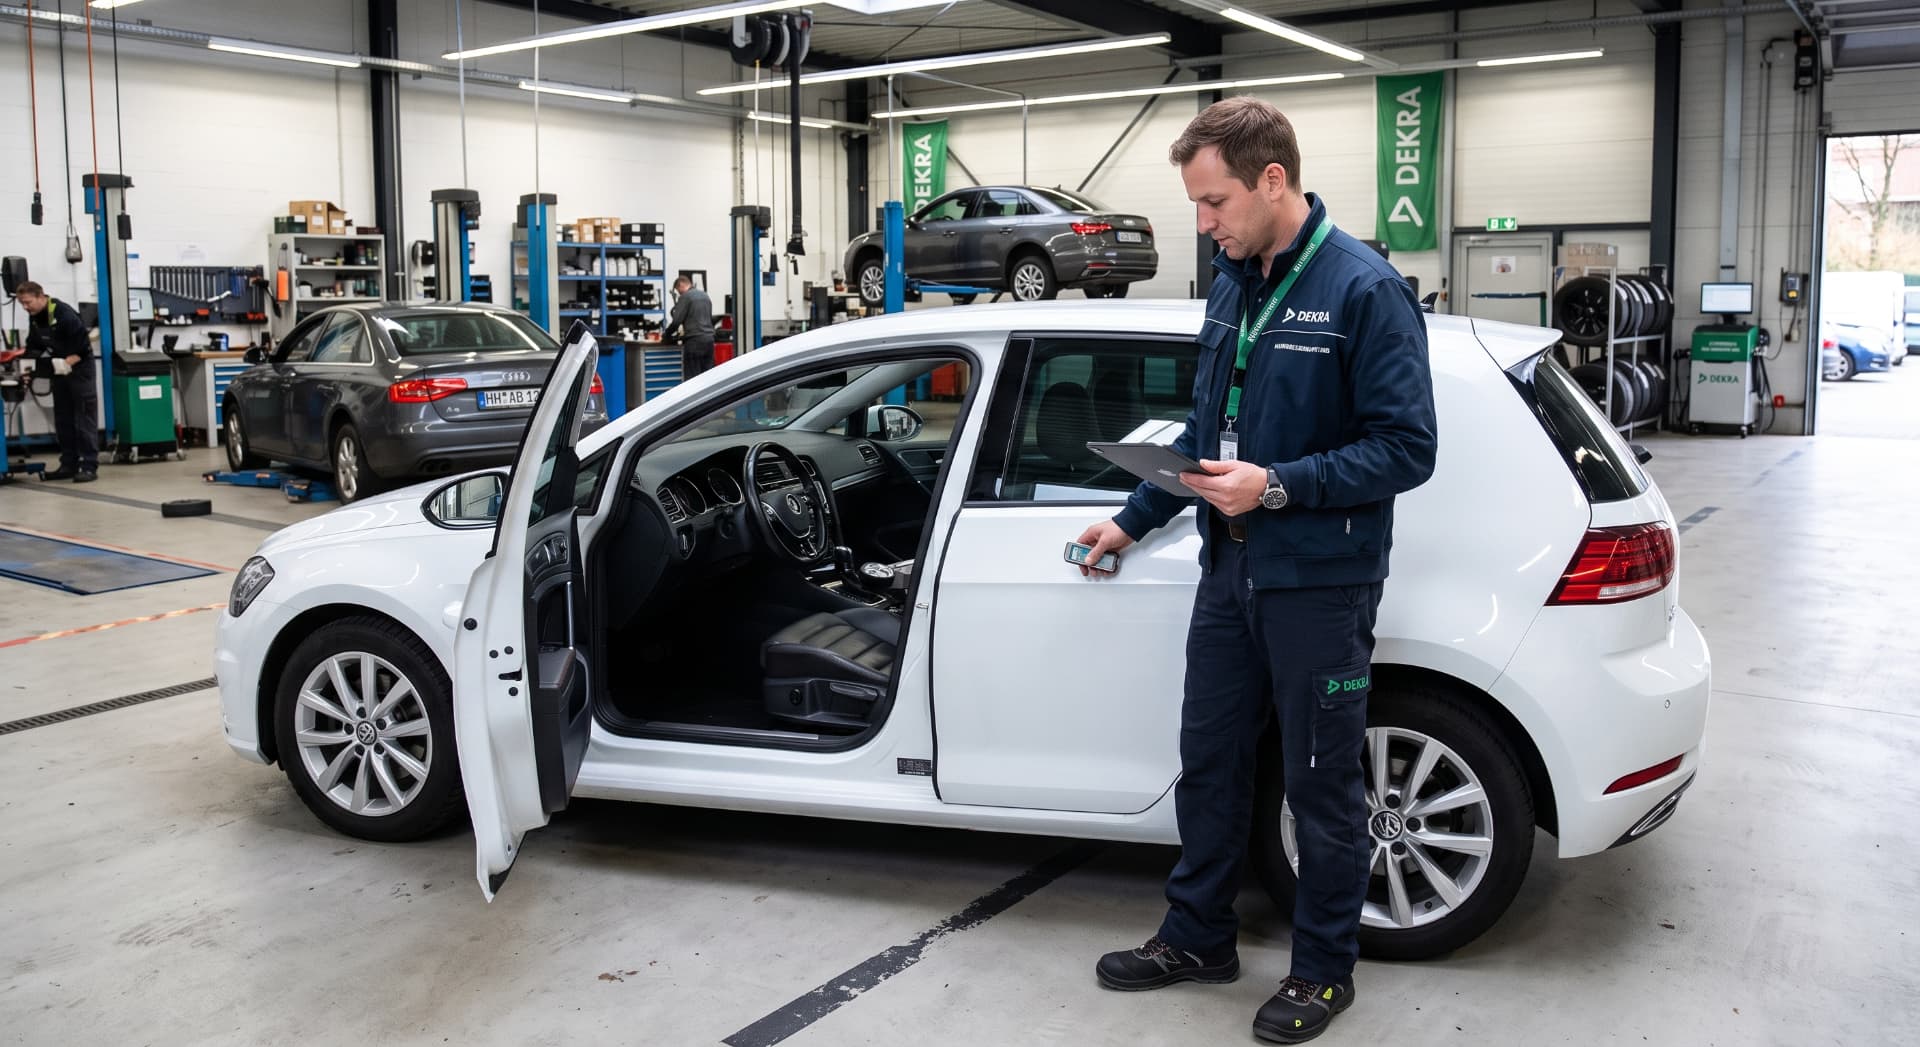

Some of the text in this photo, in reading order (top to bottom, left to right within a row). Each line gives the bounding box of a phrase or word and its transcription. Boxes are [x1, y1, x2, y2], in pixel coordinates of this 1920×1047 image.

[1396, 86, 1422, 185] DEKRA
[1297, 311, 1330, 323] DEKRA
[1709, 374, 1739, 384] DEKRA
[485, 391, 502, 405] HH
[510, 391, 524, 403] AB
